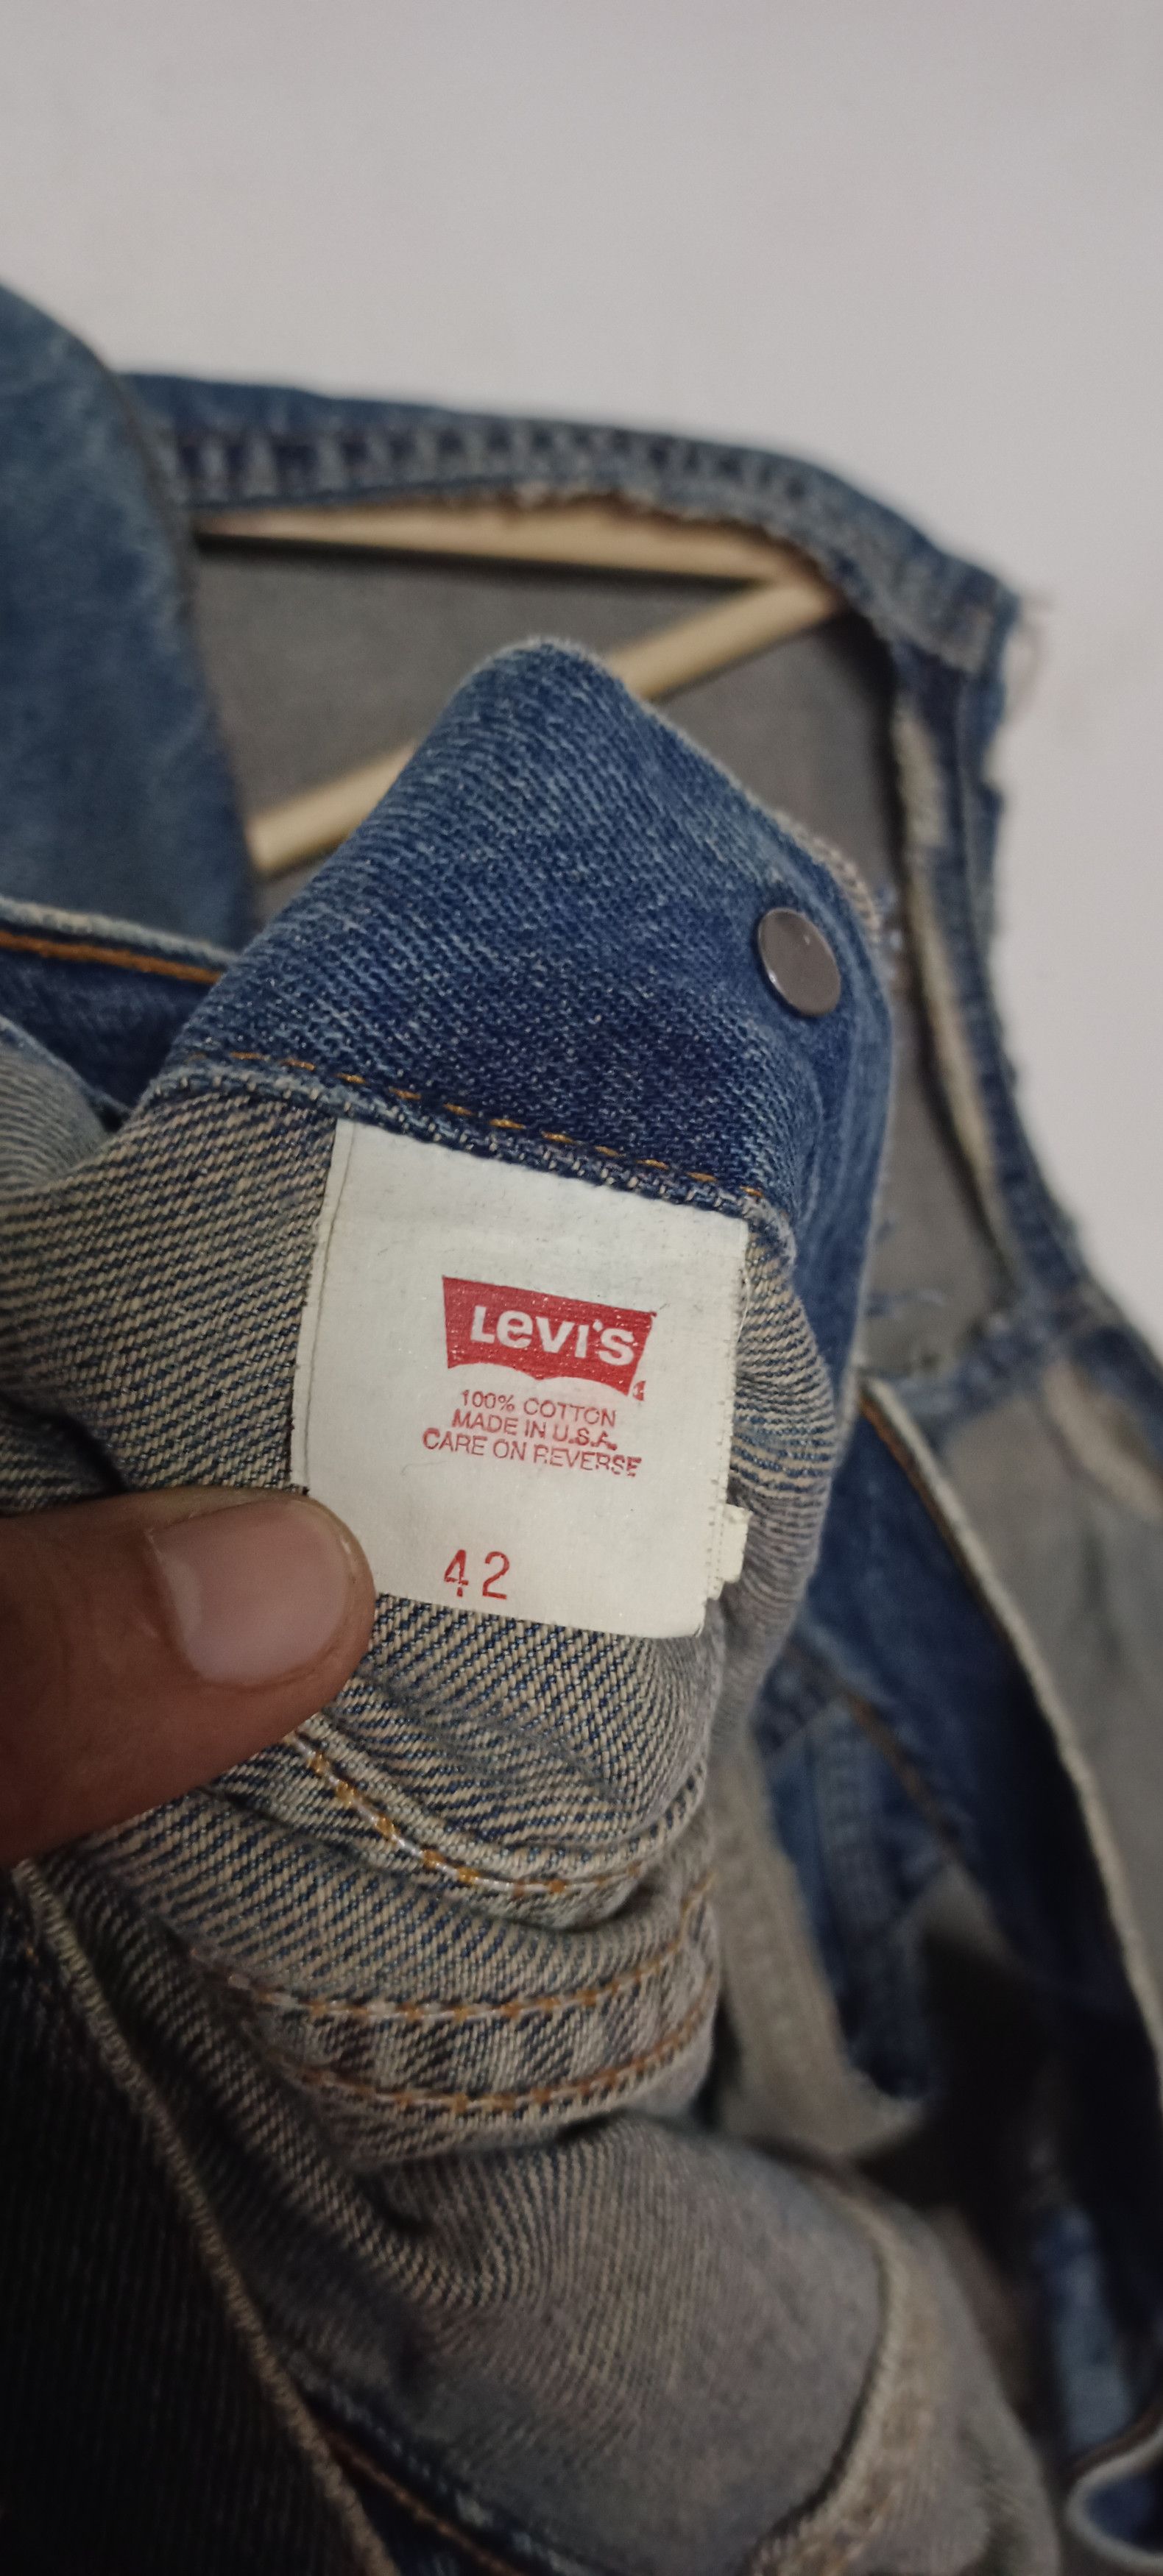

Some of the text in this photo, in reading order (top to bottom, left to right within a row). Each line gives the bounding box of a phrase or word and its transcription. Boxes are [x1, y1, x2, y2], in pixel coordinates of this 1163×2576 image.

[451, 1409, 618, 1451] MADE IN U.S.A.
[461, 1390, 616, 1427] 100% COTTON
[422, 1428, 643, 1477] CARE ON REVERSE
[443, 1549, 510, 1600] 42
